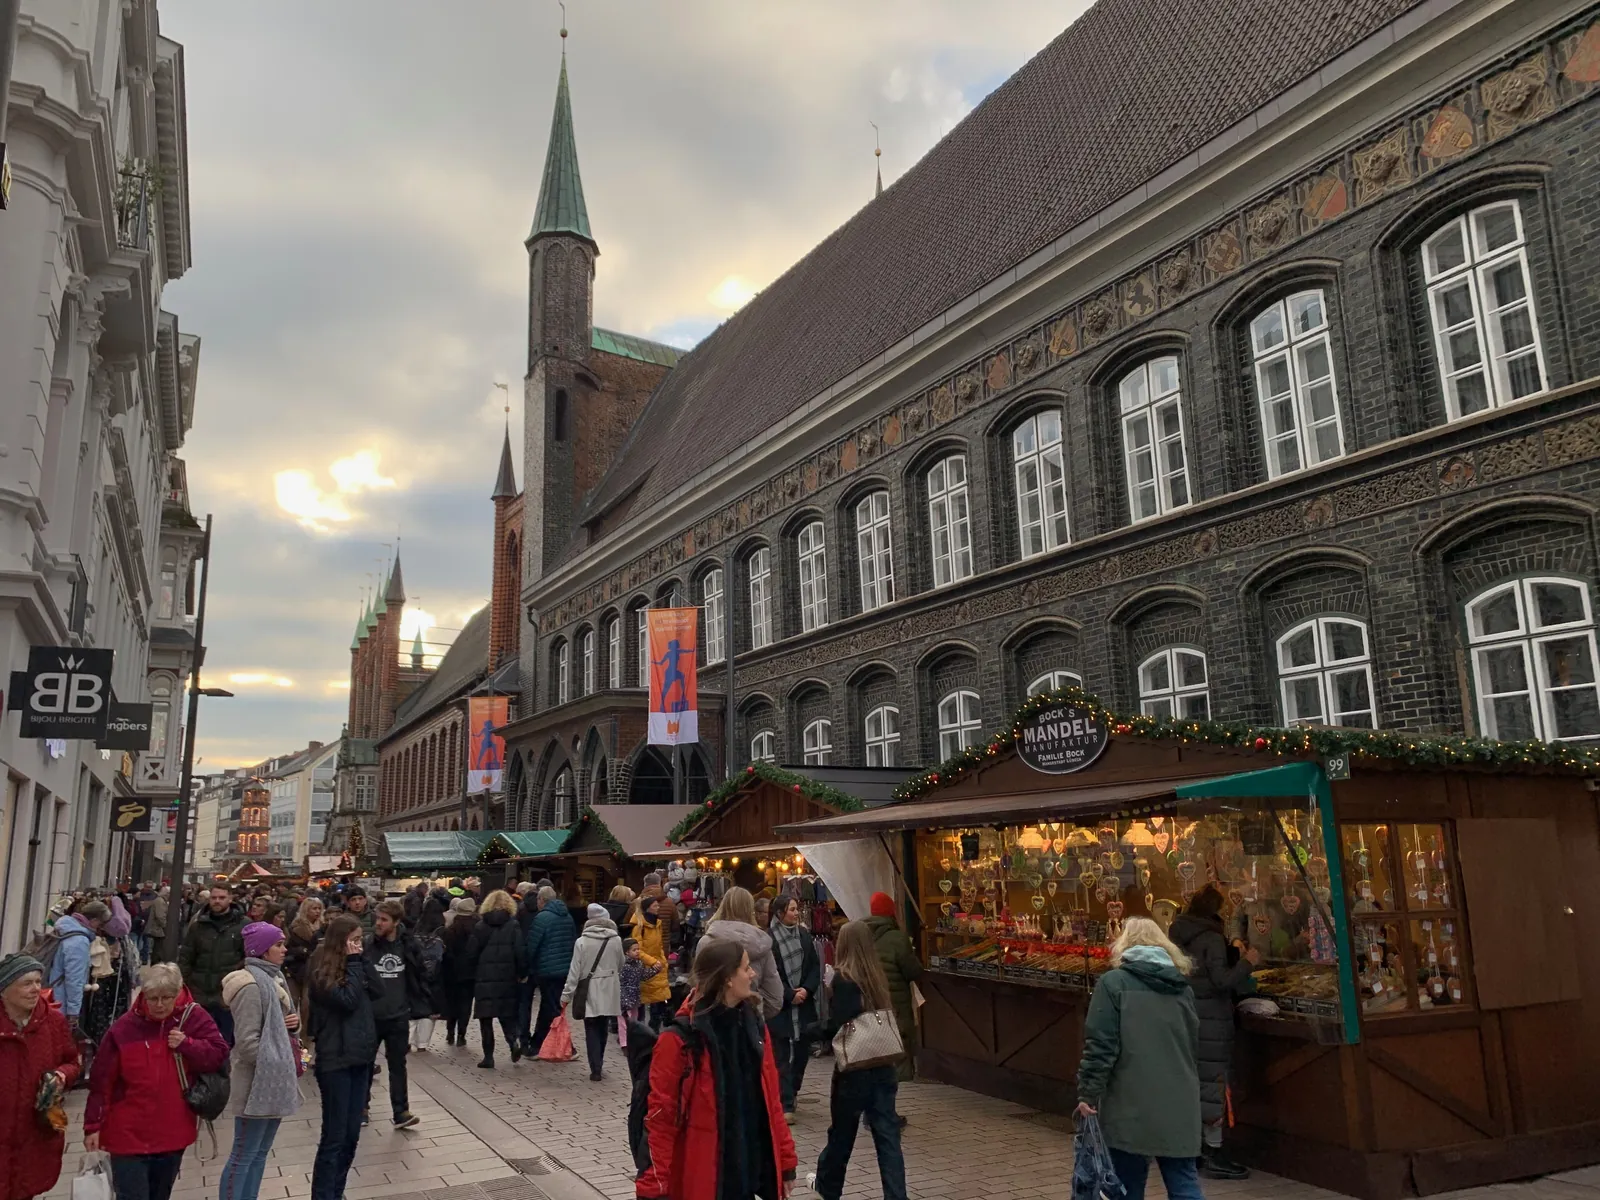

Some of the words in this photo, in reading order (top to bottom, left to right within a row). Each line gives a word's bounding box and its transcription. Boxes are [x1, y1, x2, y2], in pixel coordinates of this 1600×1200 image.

[30, 715, 56, 723] BIJOU
[58, 716, 96, 724] BRIGITTE
[1023, 717, 1097, 744] MANDEL
[1025, 735, 1098, 753] MANUFAKTUR
[1038, 752, 1064, 762] FAMILIE
[1065, 749, 1085, 758] BOCK
[1329, 758, 1344, 771] 99
